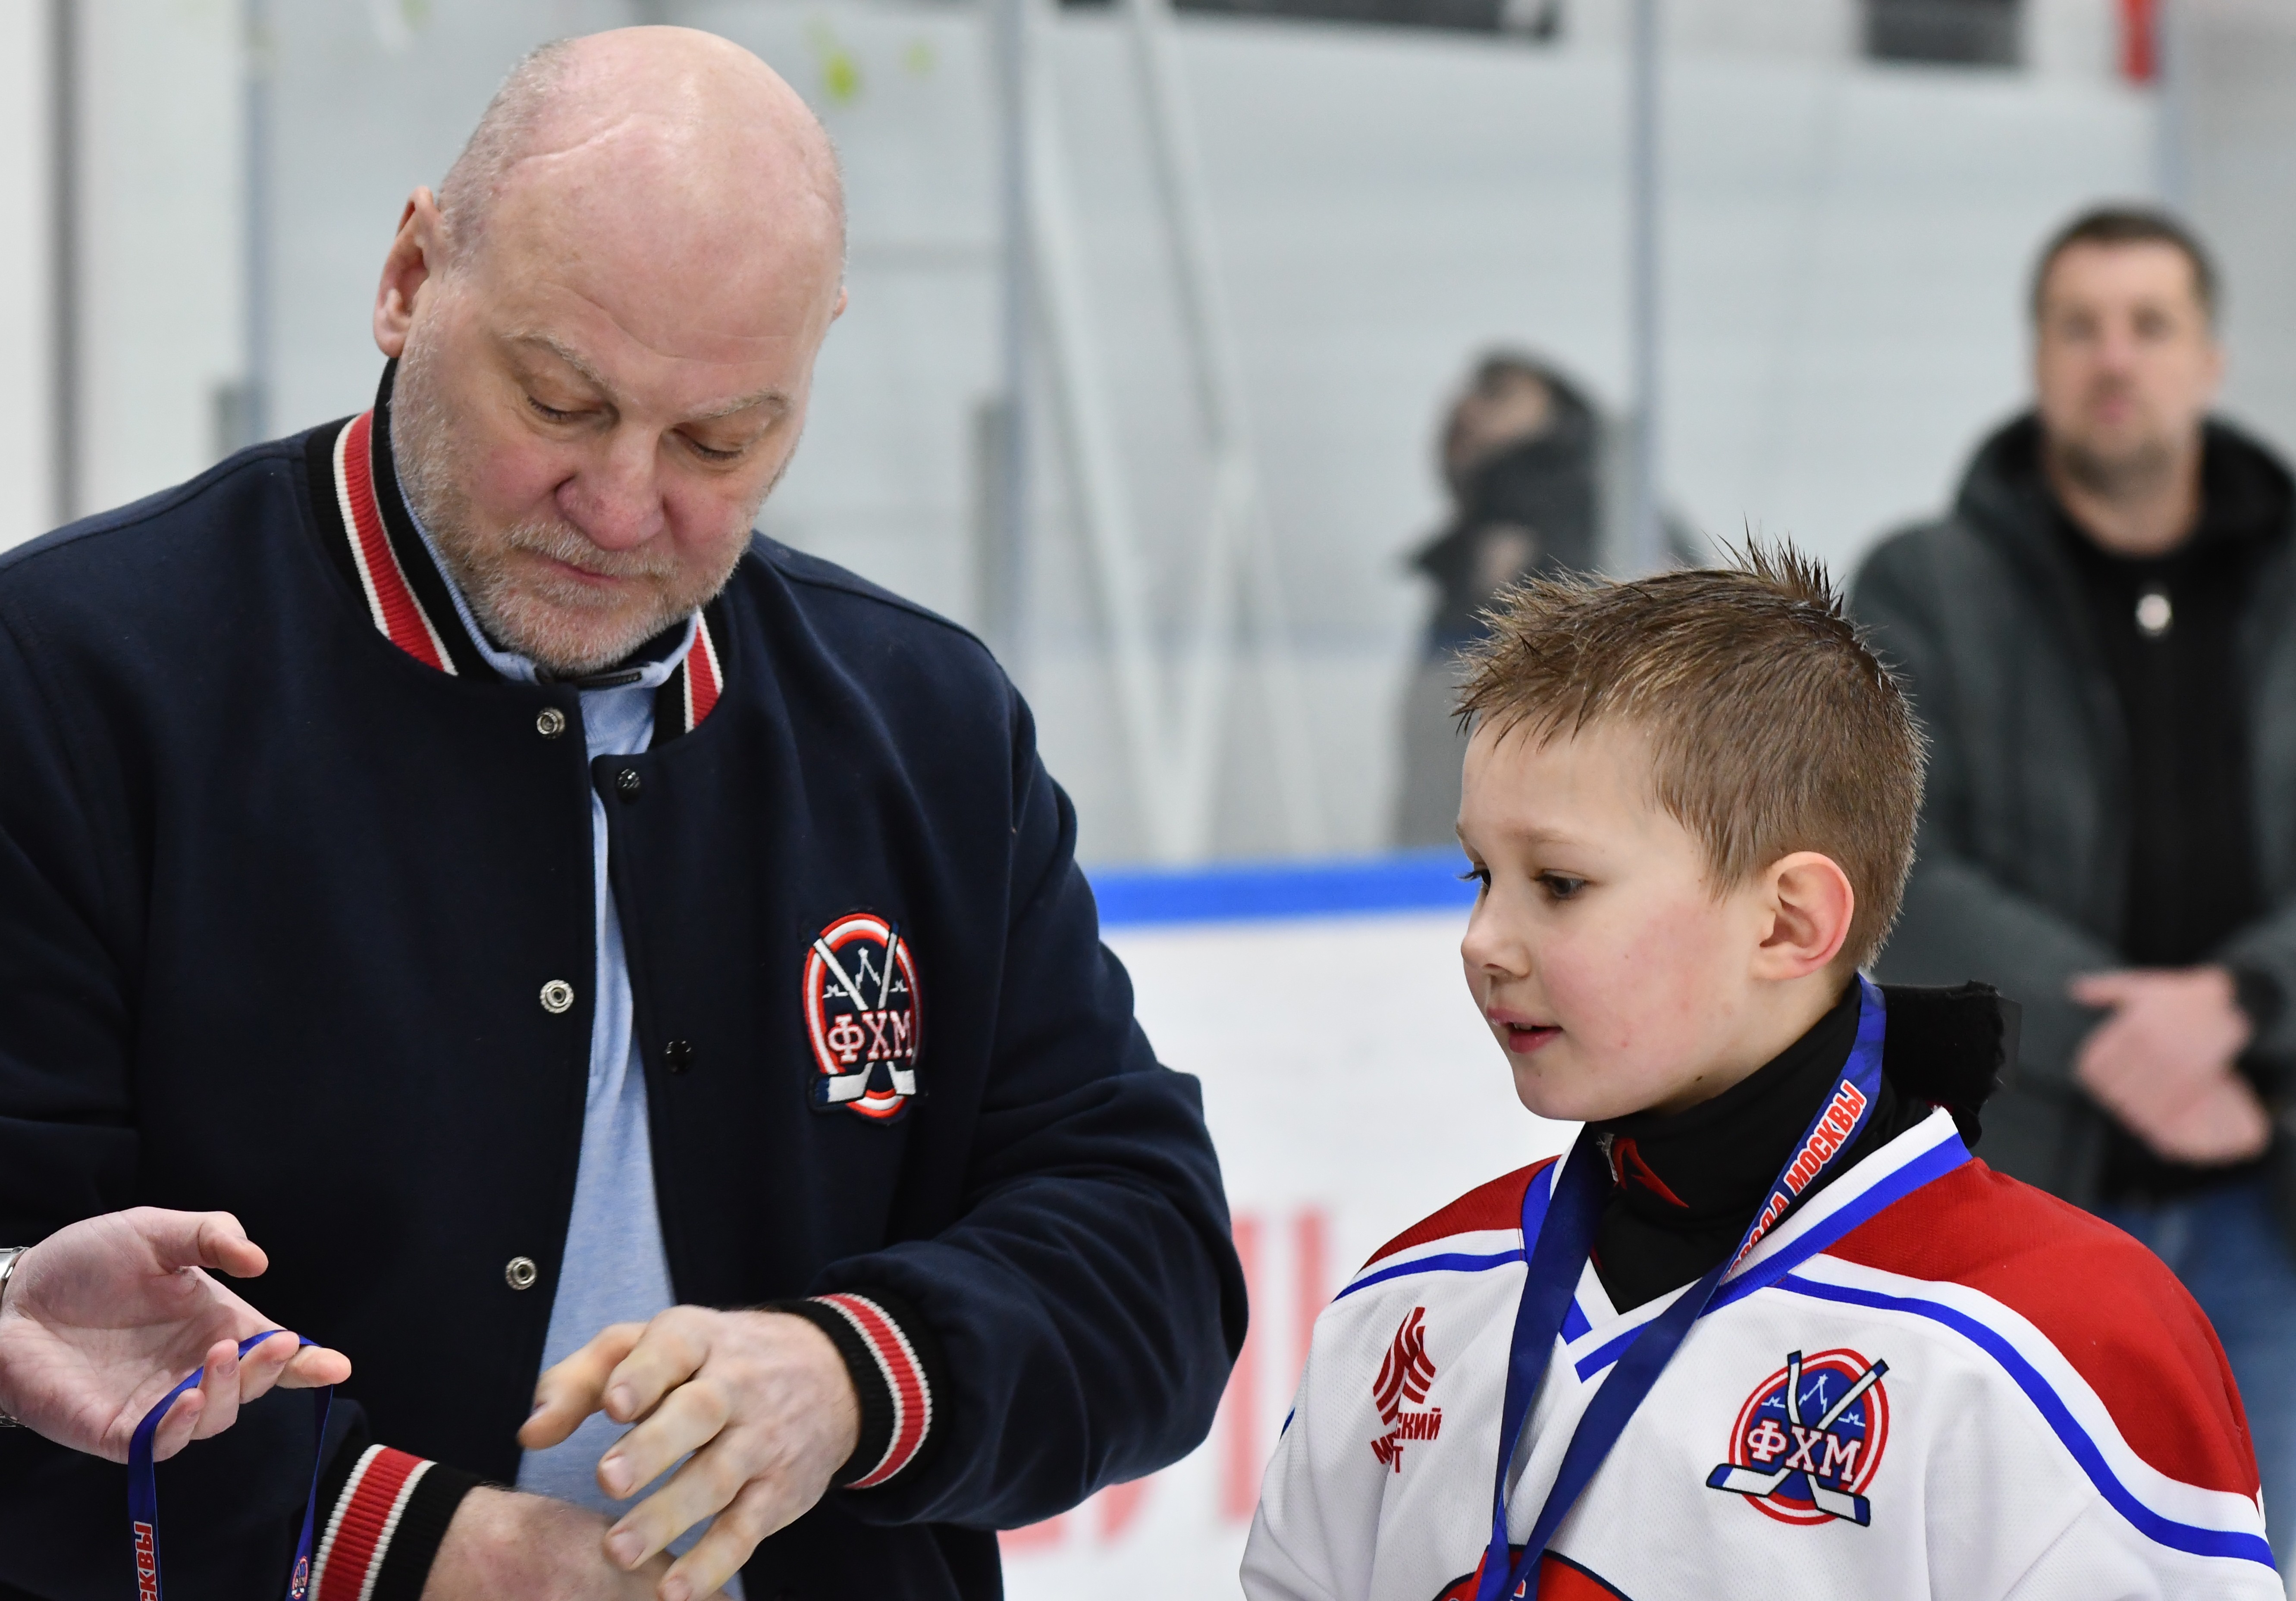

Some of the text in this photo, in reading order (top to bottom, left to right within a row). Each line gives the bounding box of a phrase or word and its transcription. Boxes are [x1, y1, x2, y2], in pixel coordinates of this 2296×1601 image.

[827, 1010, 913, 1063] ФХМ
[1784, 1079, 1867, 1196] МОСКВЫ
[1746, 1418, 1863, 1484] ФХМ
